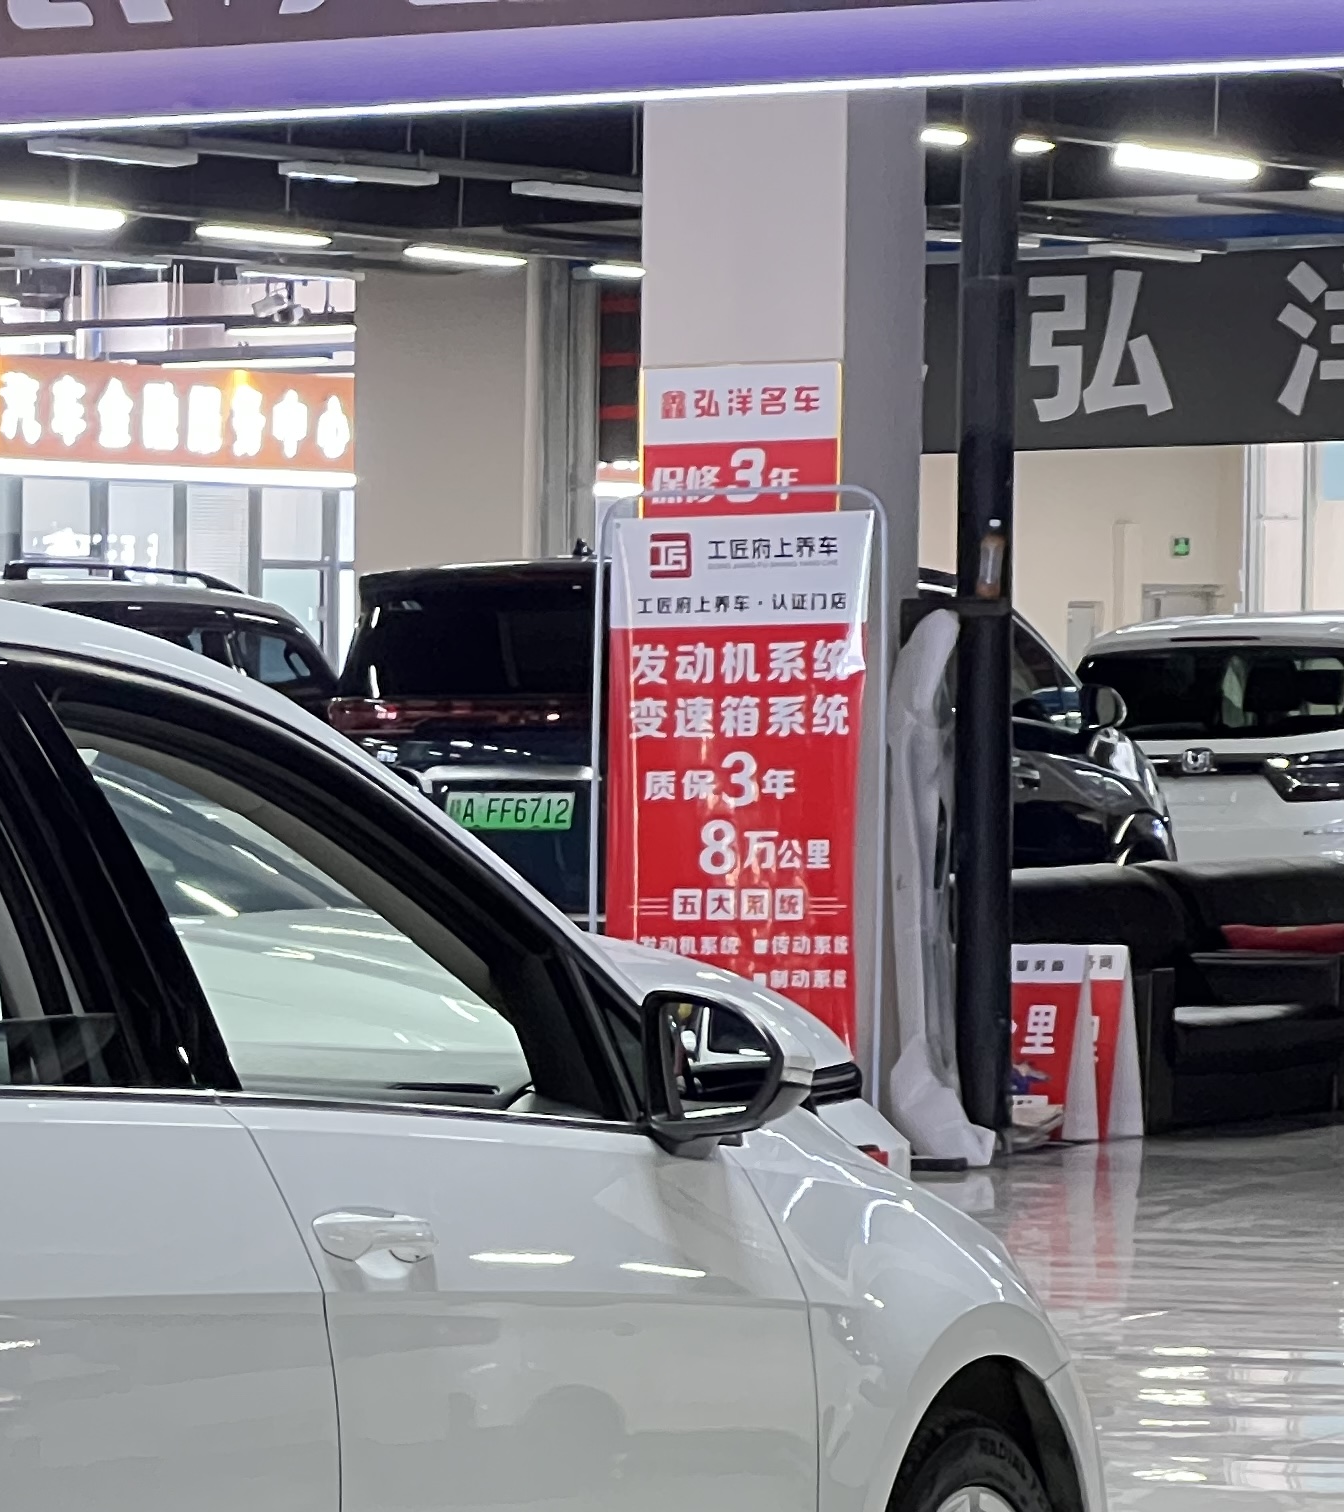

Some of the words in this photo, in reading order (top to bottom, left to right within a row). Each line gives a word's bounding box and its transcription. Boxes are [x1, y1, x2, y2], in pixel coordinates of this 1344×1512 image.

[661, 386, 820, 419] 鑫弘洋名车
[651, 448, 799, 504] 保修3年
[708, 536, 838, 560] 工匠府上养车
[631, 641, 853, 684] 发动机系统
[629, 694, 849, 739] 变速箱系统
[644, 751, 796, 807] 质保3年
[699, 819, 831, 875] 8万公里
[676, 891, 801, 918] 五大系统
